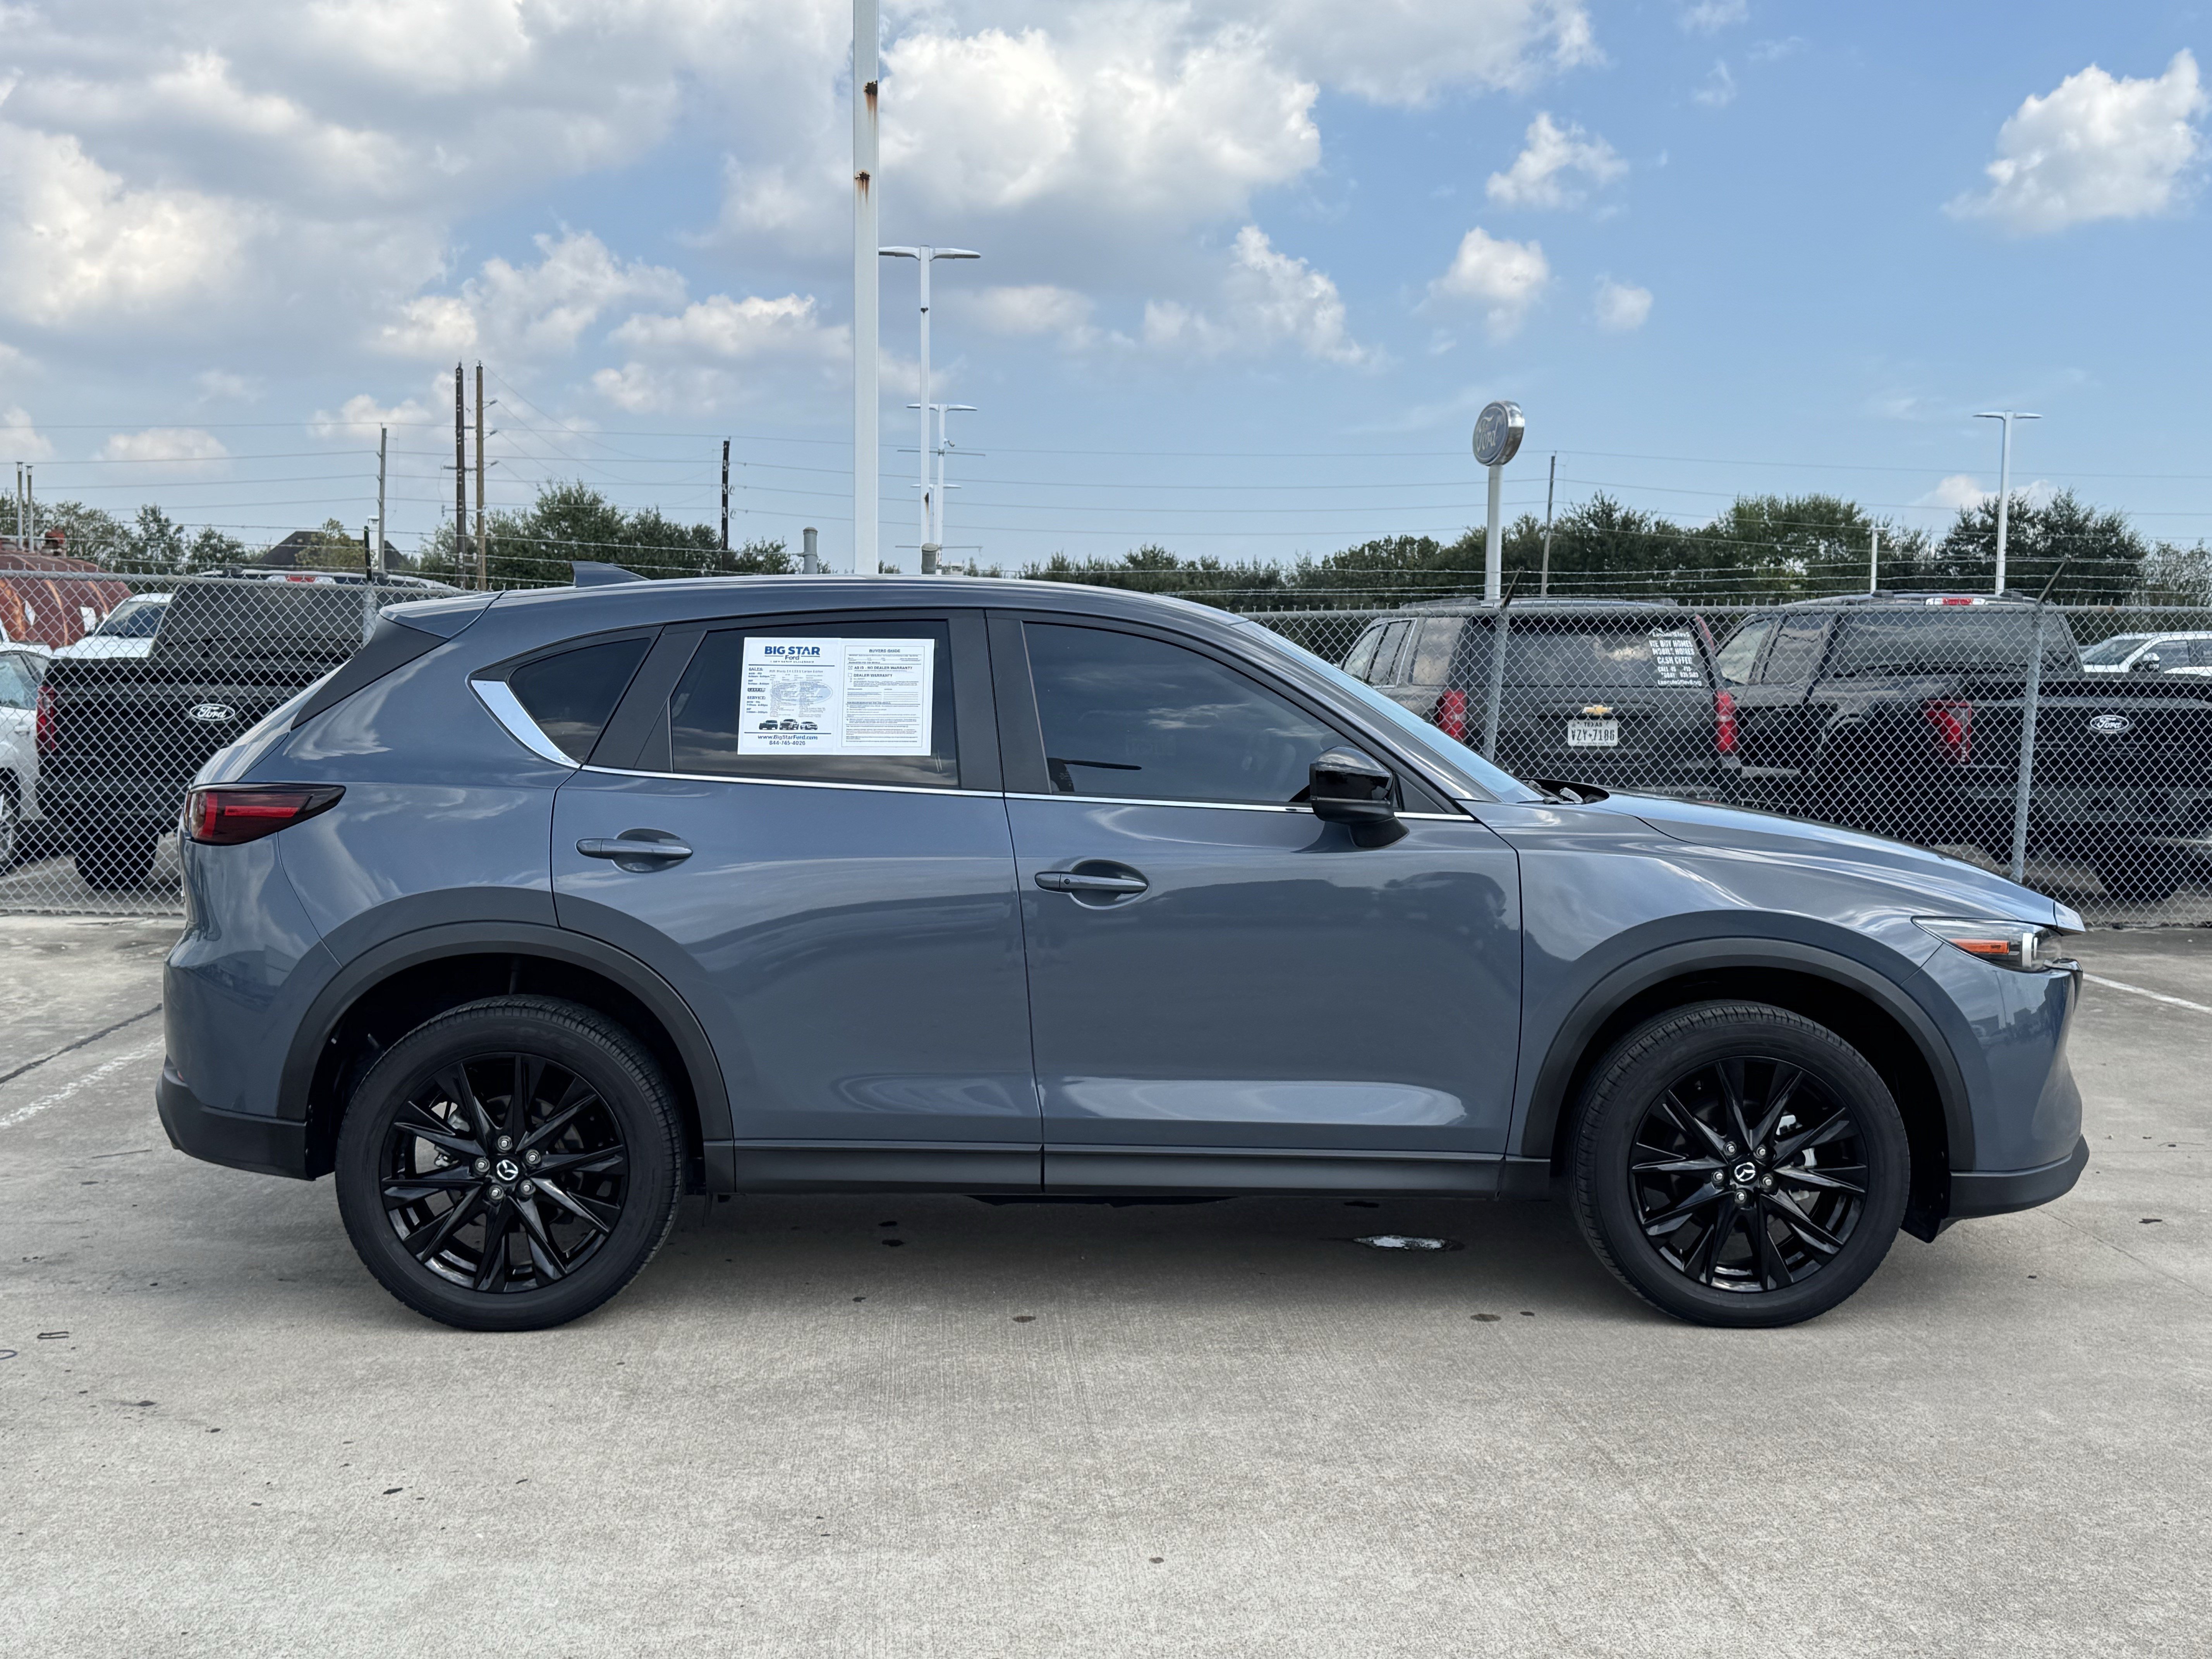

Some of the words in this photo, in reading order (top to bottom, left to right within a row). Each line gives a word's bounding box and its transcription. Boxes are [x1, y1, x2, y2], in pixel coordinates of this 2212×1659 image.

[1476, 415, 1499, 452] Ford
[764, 646, 785, 654] BIG
[788, 646, 820, 655] STAR
[197, 706, 227, 718] Ford
